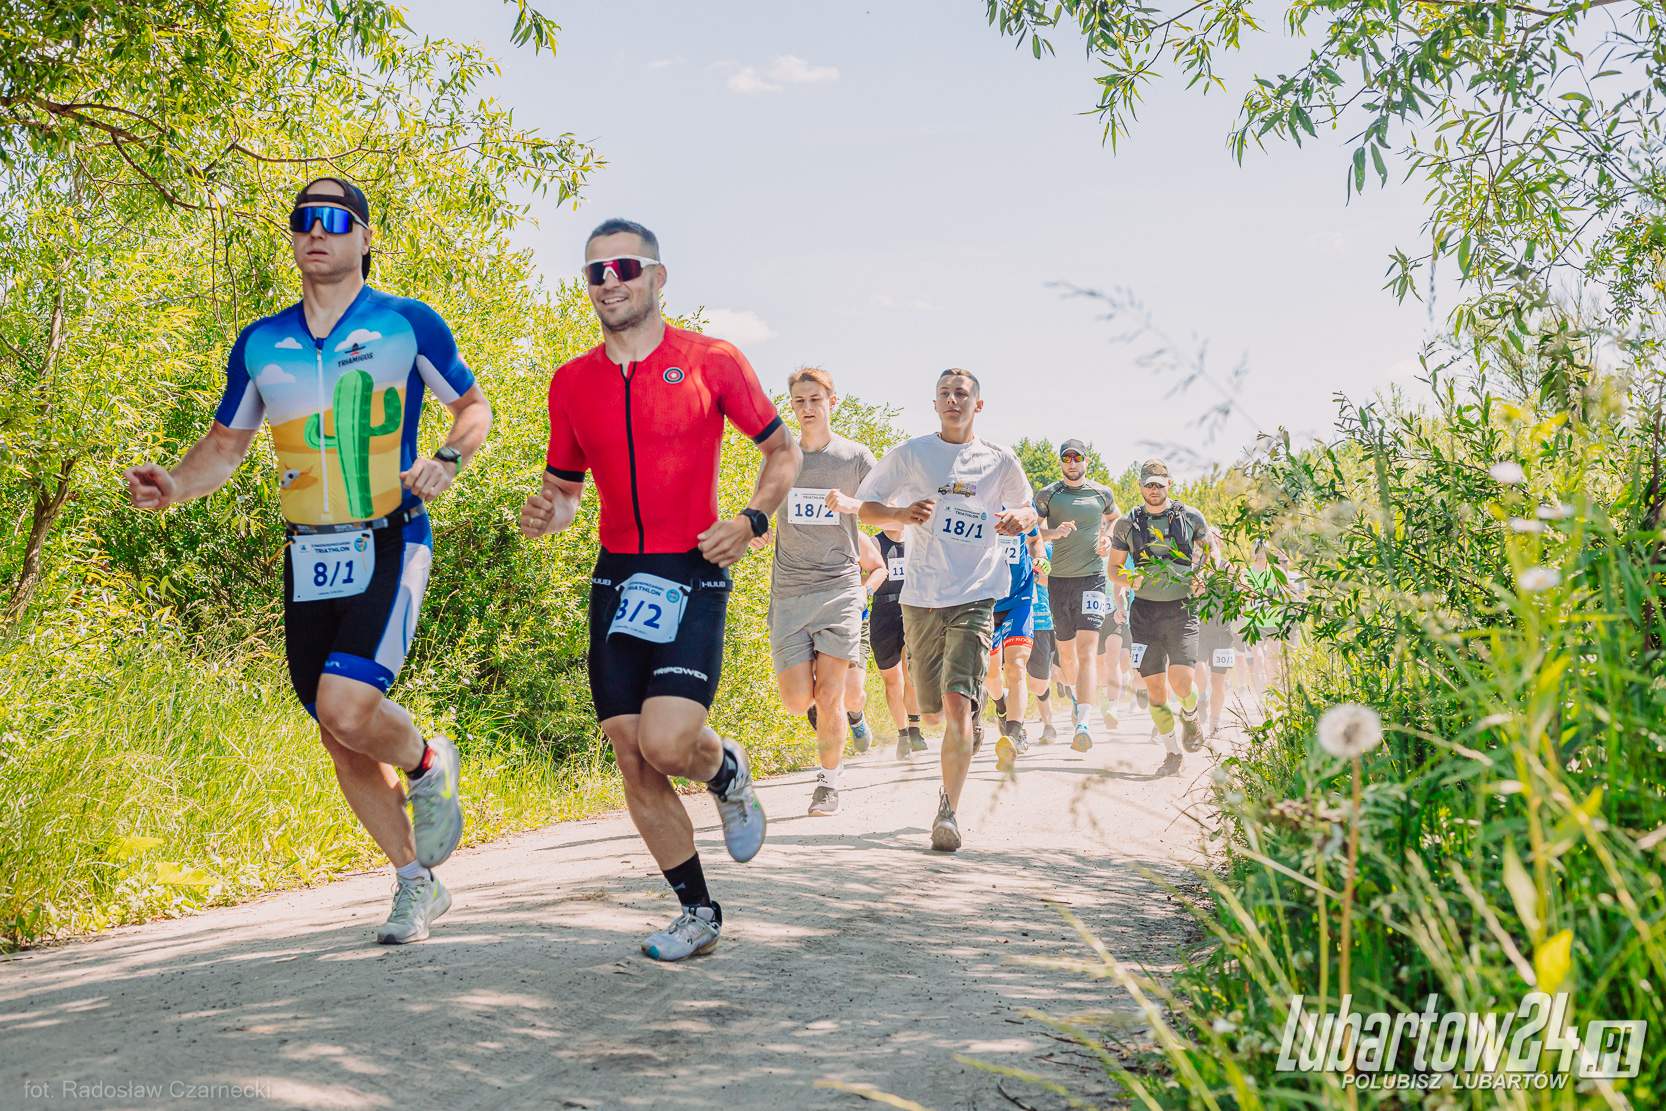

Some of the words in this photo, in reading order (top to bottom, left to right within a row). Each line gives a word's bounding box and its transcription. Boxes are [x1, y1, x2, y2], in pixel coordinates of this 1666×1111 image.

[794, 503, 834, 518] 18/2
[943, 518, 983, 538] 18/1
[313, 560, 354, 587] 8/1
